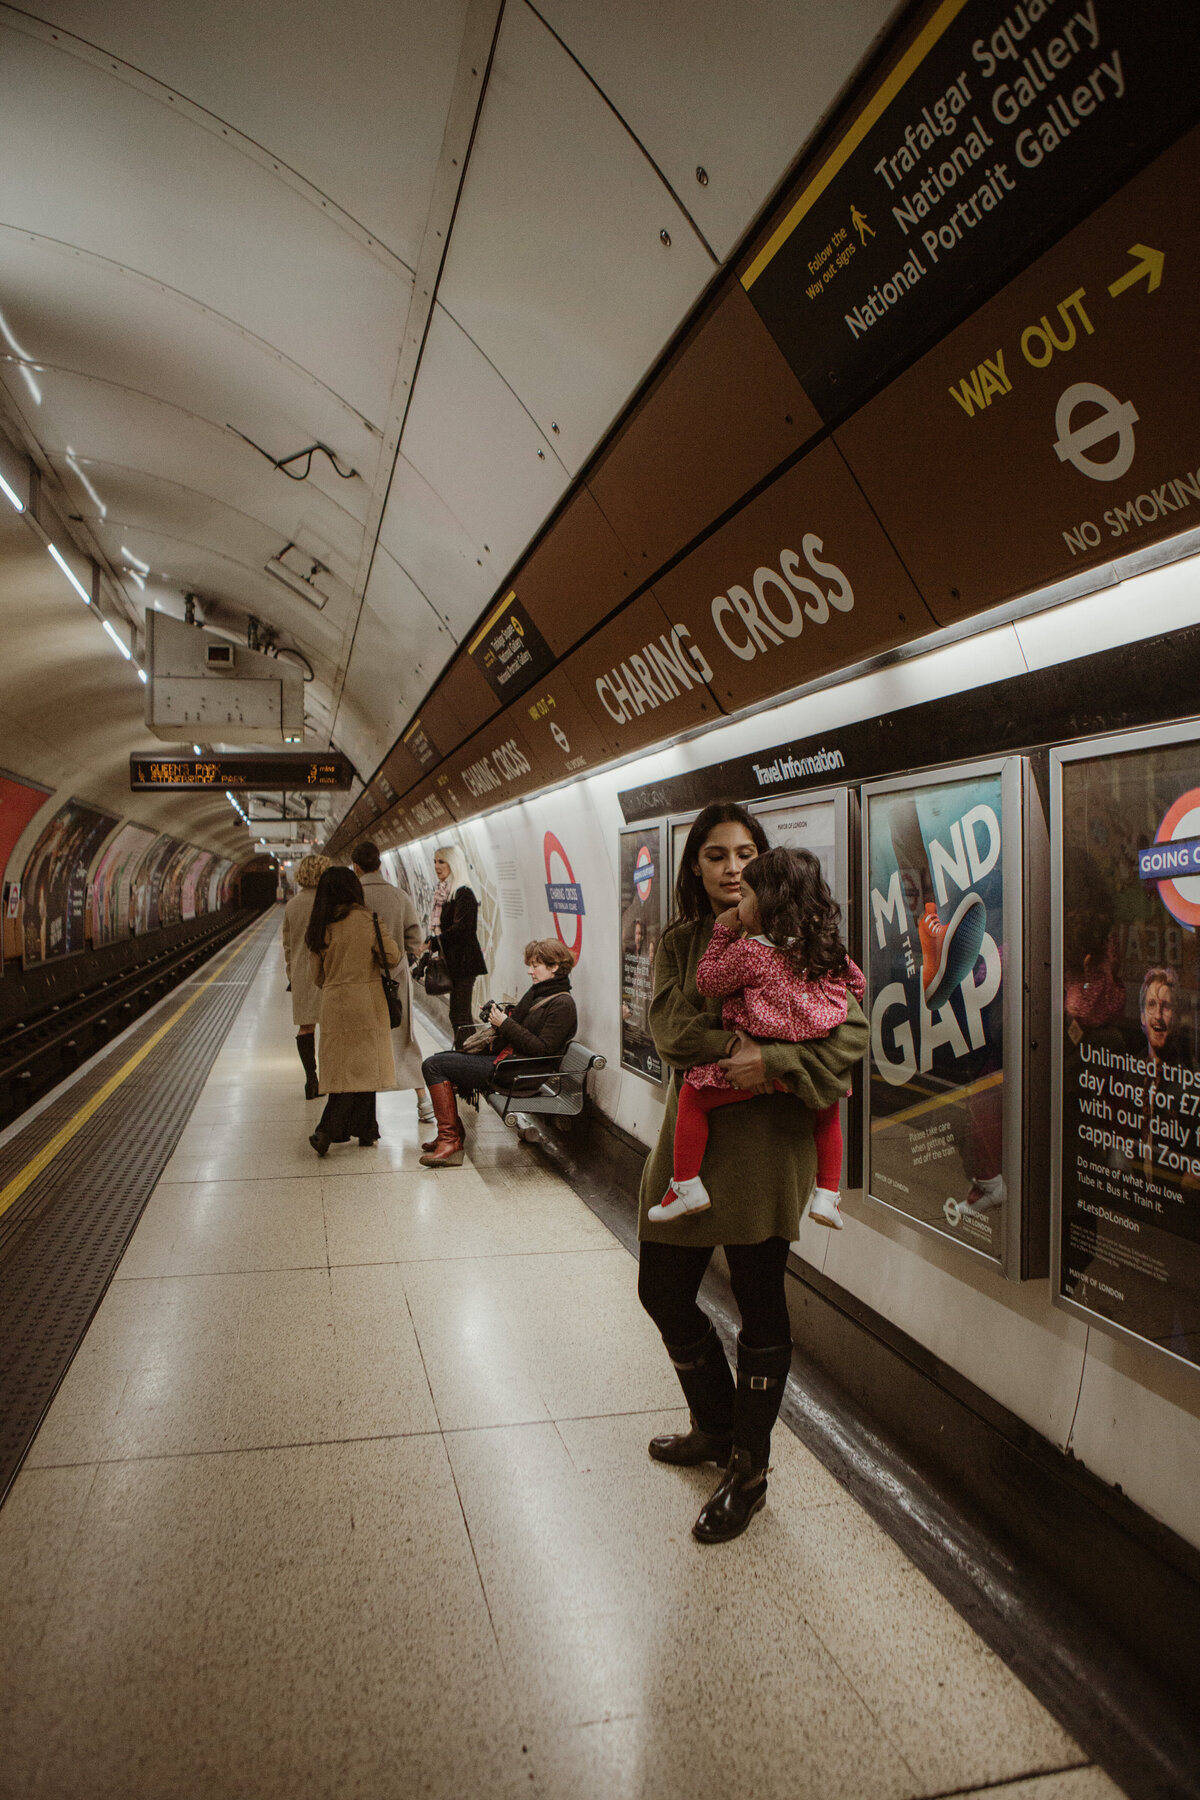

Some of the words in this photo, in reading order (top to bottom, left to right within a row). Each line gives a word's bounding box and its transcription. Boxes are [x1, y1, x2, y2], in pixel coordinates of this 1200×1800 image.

[874, 71, 972, 191] Trafalgar
[892, 116, 994, 235] National
[991, 0, 1099, 125] Gallery
[844, 248, 927, 340] National
[921, 163, 1016, 263] Portrait
[1015, 49, 1126, 168] Gallery
[805, 279, 824, 300] Way
[823, 262, 838, 284] out
[835, 241, 857, 271] signs
[807, 242, 833, 276] Follow
[831, 227, 848, 249] the
[948, 348, 1013, 417] WAY
[1020, 287, 1095, 368] OUT
[1061, 521, 1101, 555] NO
[595, 623, 714, 725] CHARING
[711, 532, 855, 661] CROSS
[461, 757, 501, 797] CHARING
[492, 739, 531, 781] CROSS
[752, 757, 783, 786] Travel
[780, 747, 845, 780] Information
[871, 803, 1000, 950] MND
[1141, 849, 1189, 872] GOING
[901, 935, 917, 978] THE
[871, 931, 1002, 1087] GAP
[1079, 1069, 1105, 1096] day
[1109, 1075, 1144, 1107] long
[1148, 1085, 1175, 1110] for
[1080, 1042, 1157, 1077] Unlimited
[1162, 1062, 1200, 1090] trips
[926, 1126, 937, 1137] take
[937, 1121, 951, 1132] care
[926, 1136, 946, 1150] getting
[945, 1133, 954, 1142] on
[1079, 1098, 1112, 1121] with
[1117, 1109, 1145, 1130] our
[1150, 1115, 1190, 1147] daily
[932, 1149, 942, 1160] the
[1078, 1124, 1134, 1159] capping
[1138, 1139, 1153, 1161] in
[1157, 1143, 1200, 1176] Zone
[1077, 1155, 1089, 1168] Do
[1090, 1162, 1110, 1177] more
[1111, 1169, 1121, 1180] of
[1122, 1173, 1144, 1189] what
[1145, 1181, 1161, 1196] you
[1163, 1186, 1185, 1204] love.
[1077, 1171, 1095, 1188] Tube
[1096, 1178, 1105, 1191] it.
[1106, 1182, 1121, 1197] Bus
[1122, 1188, 1131, 1201] it.
[1132, 1191, 1153, 1209] Train
[1077, 1199, 1140, 1233] #LetsDoLondon
[1068, 1268, 1089, 1283] MAYOR
[1089, 1277, 1098, 1287] OF
[1098, 1280, 1124, 1301] LONDON
